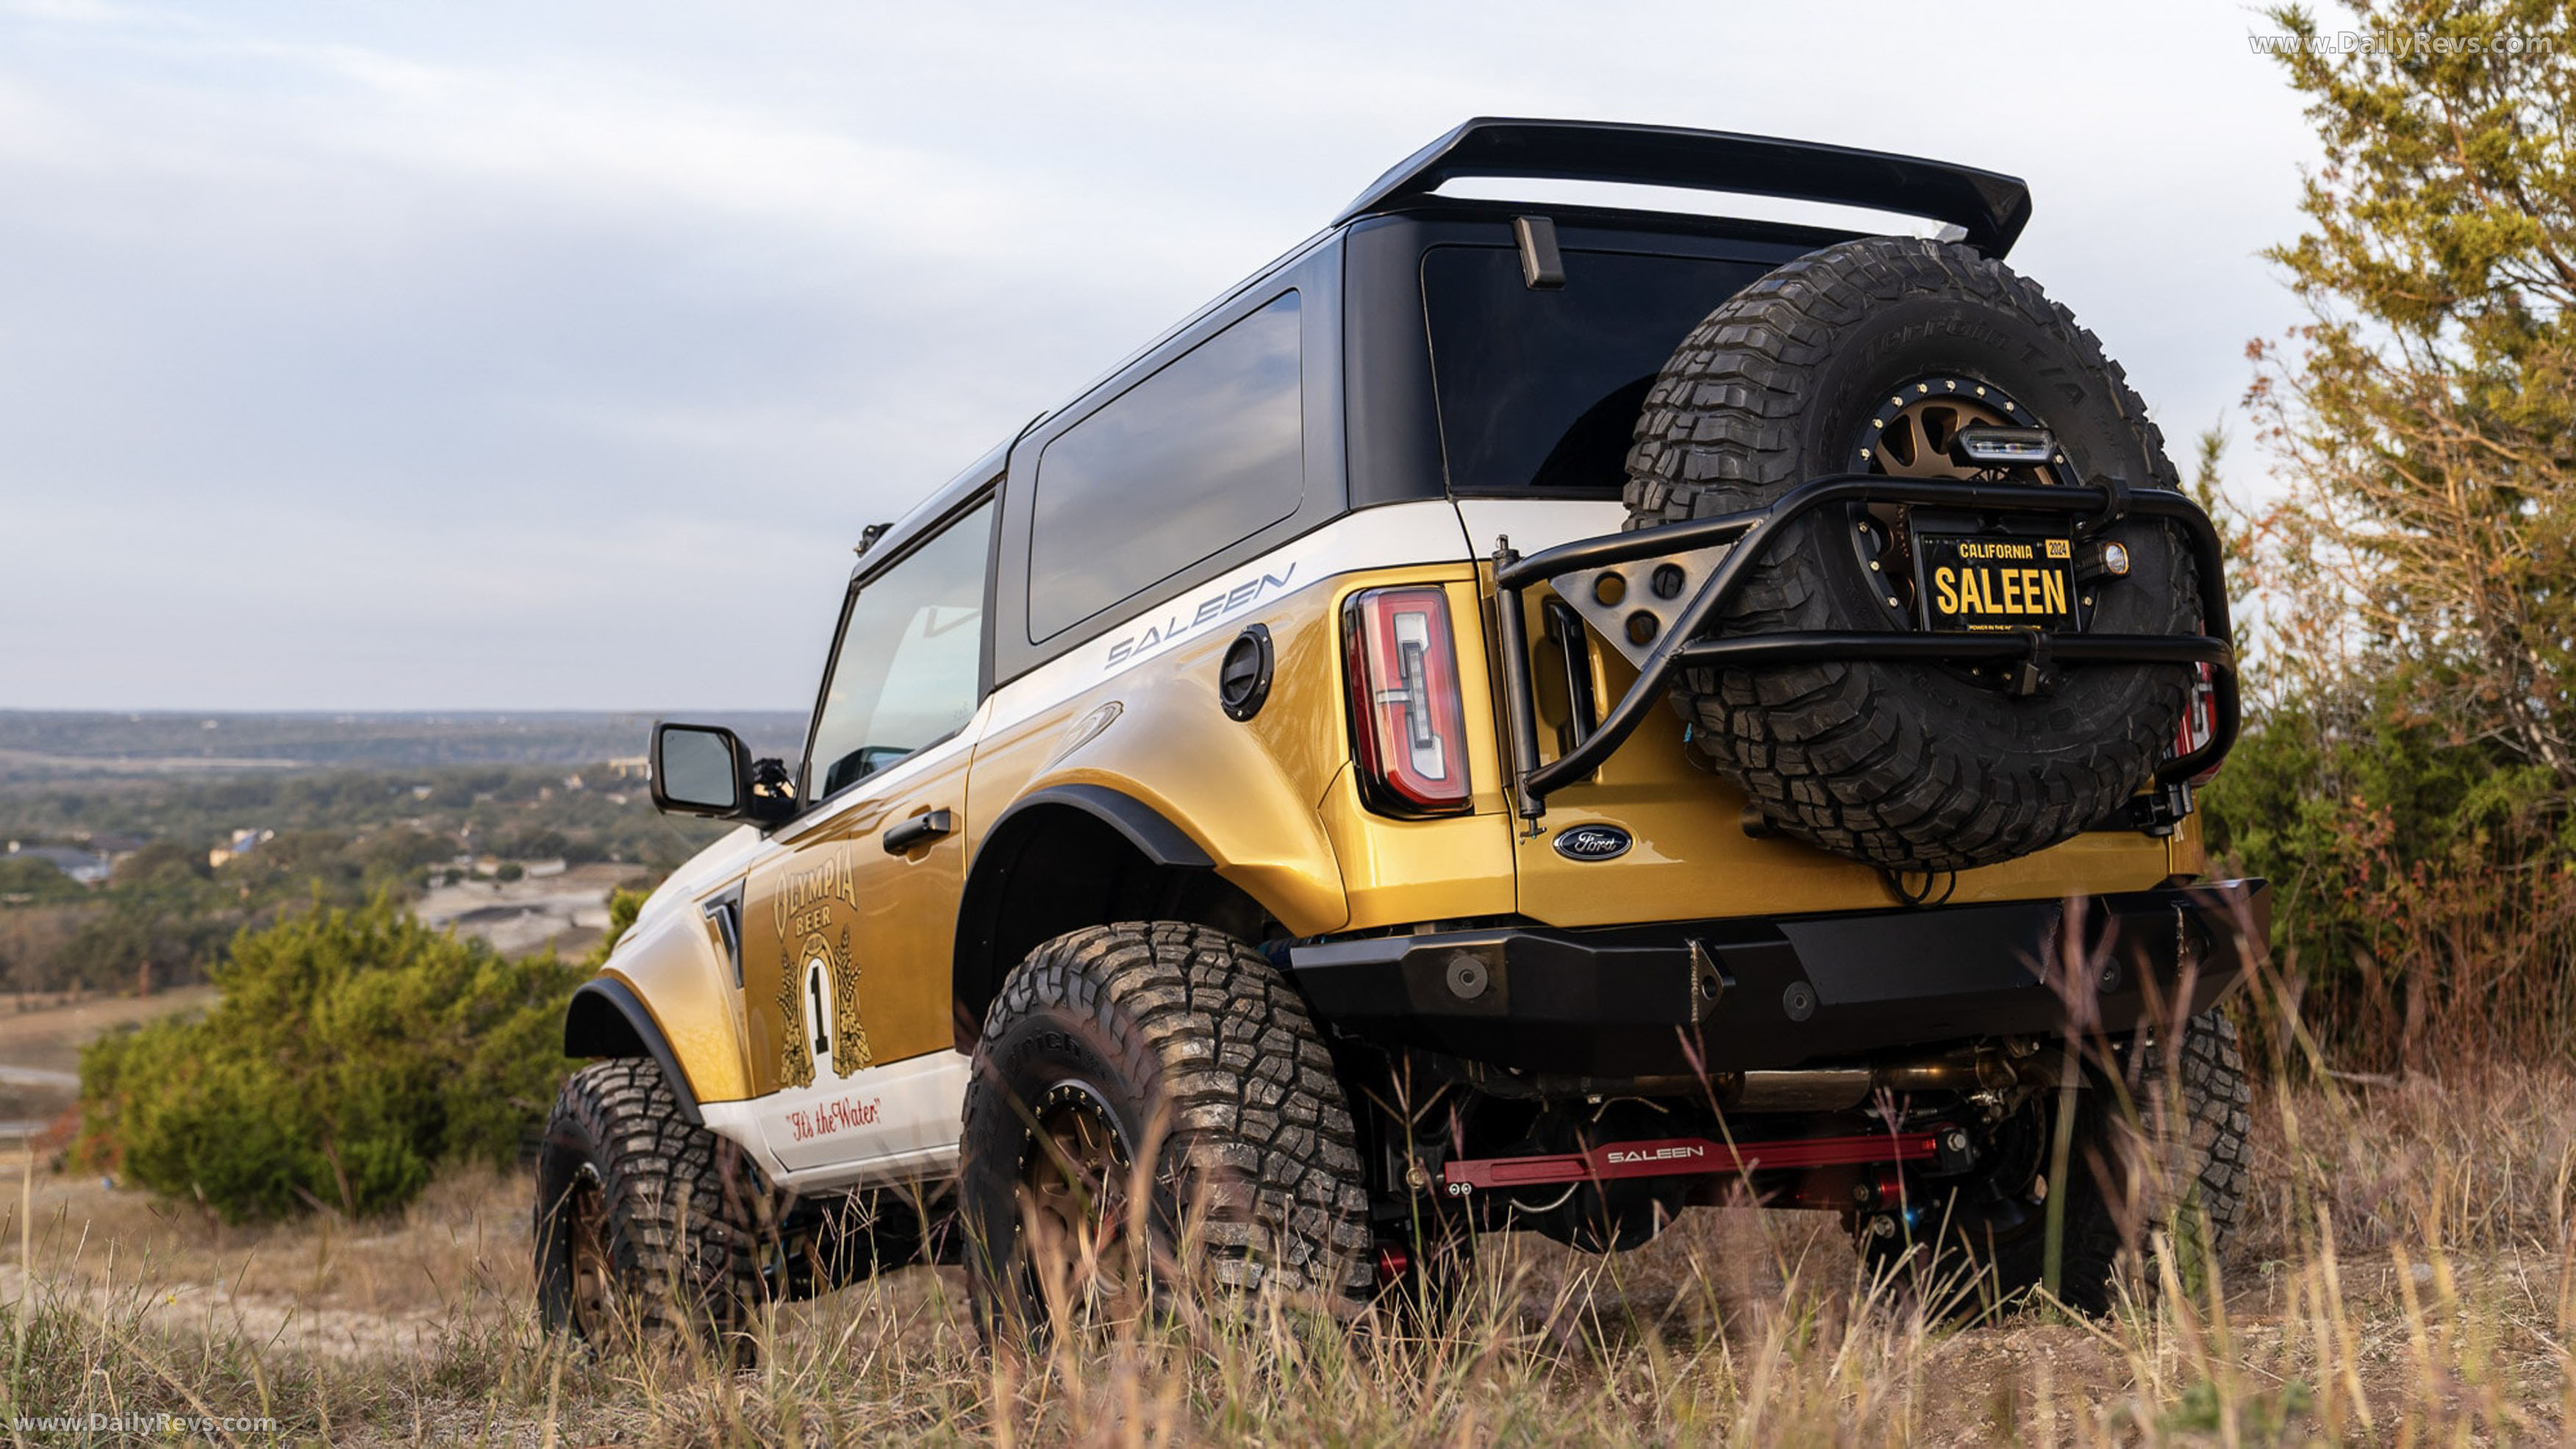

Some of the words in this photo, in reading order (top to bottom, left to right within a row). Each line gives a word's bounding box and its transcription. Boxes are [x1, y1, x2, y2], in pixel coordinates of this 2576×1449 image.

[1959, 543, 2033, 559] CALIFORNIA
[2048, 541, 2067, 555] 2024
[1935, 566, 2067, 614] SALEEN
[1104, 562, 1297, 670] SALEEN
[1574, 831, 1617, 853] Ford
[774, 841, 858, 944] OLYMPIA
[795, 904, 832, 938] BEER
[811, 965, 829, 1056] 1
[817, 1103, 837, 1134] the
[1608, 1145, 1704, 1163] SALEEN
